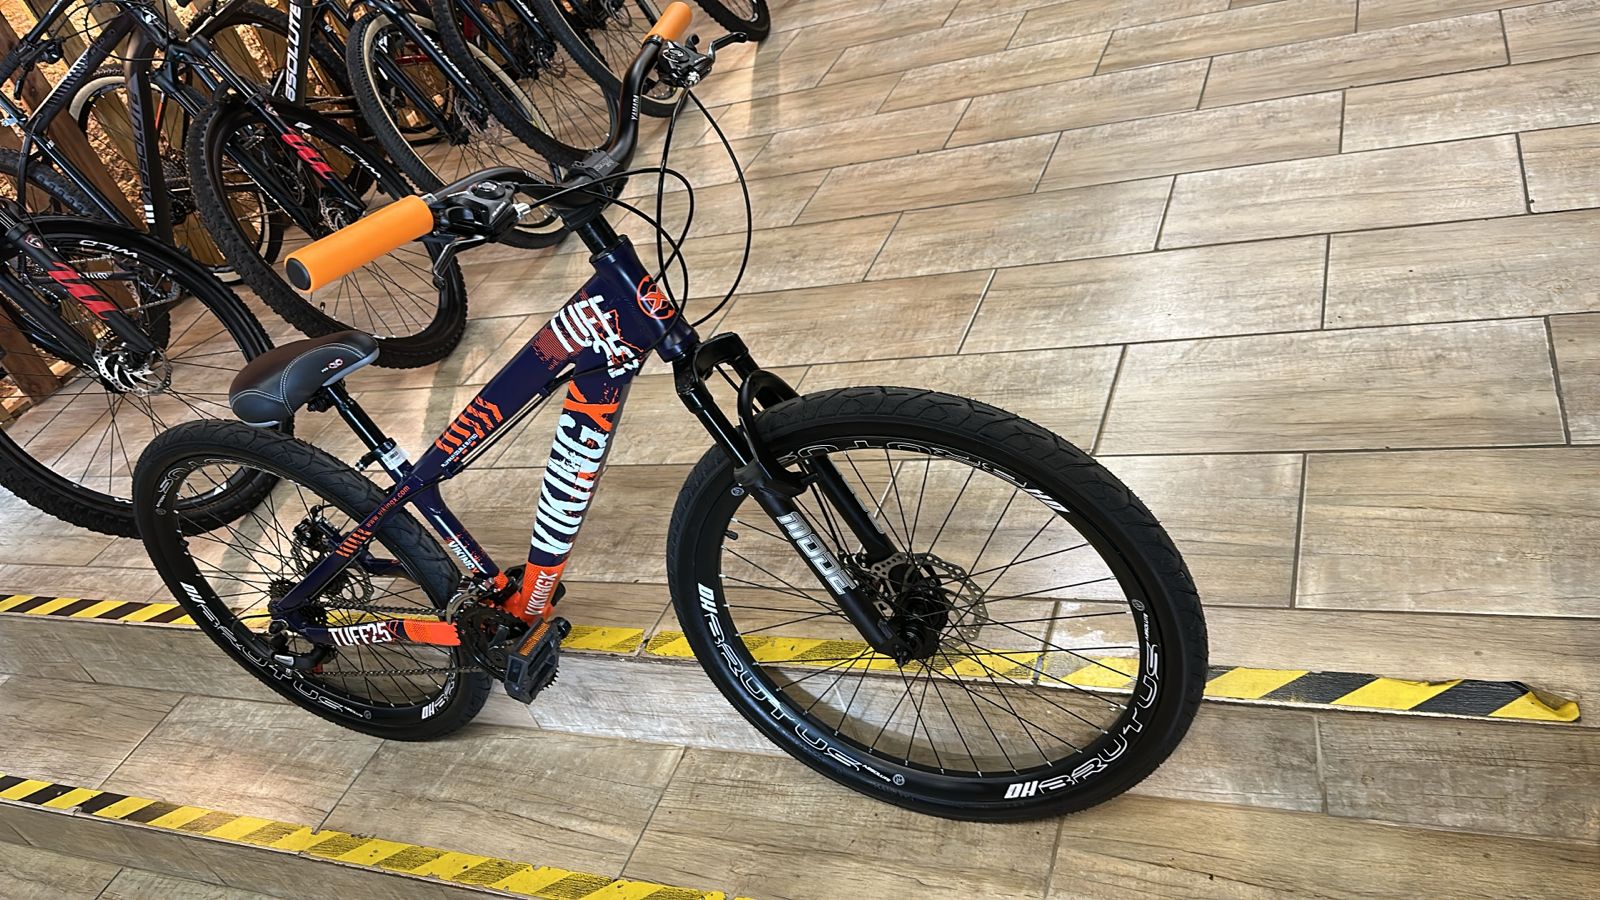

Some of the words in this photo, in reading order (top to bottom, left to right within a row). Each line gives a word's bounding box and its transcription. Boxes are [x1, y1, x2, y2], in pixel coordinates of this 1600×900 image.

[285, 3, 301, 102] BSOLUTE
[79, 239, 139, 259] WILD
[776, 511, 857, 595] MODE
[180, 581, 206, 605] DH
[697, 582, 718, 615] DH
[327, 621, 393, 647] TUFF25
[704, 613, 863, 772] BRUTUS
[1003, 780, 1039, 800] DH
[1038, 642, 1160, 795] BRUTUS
